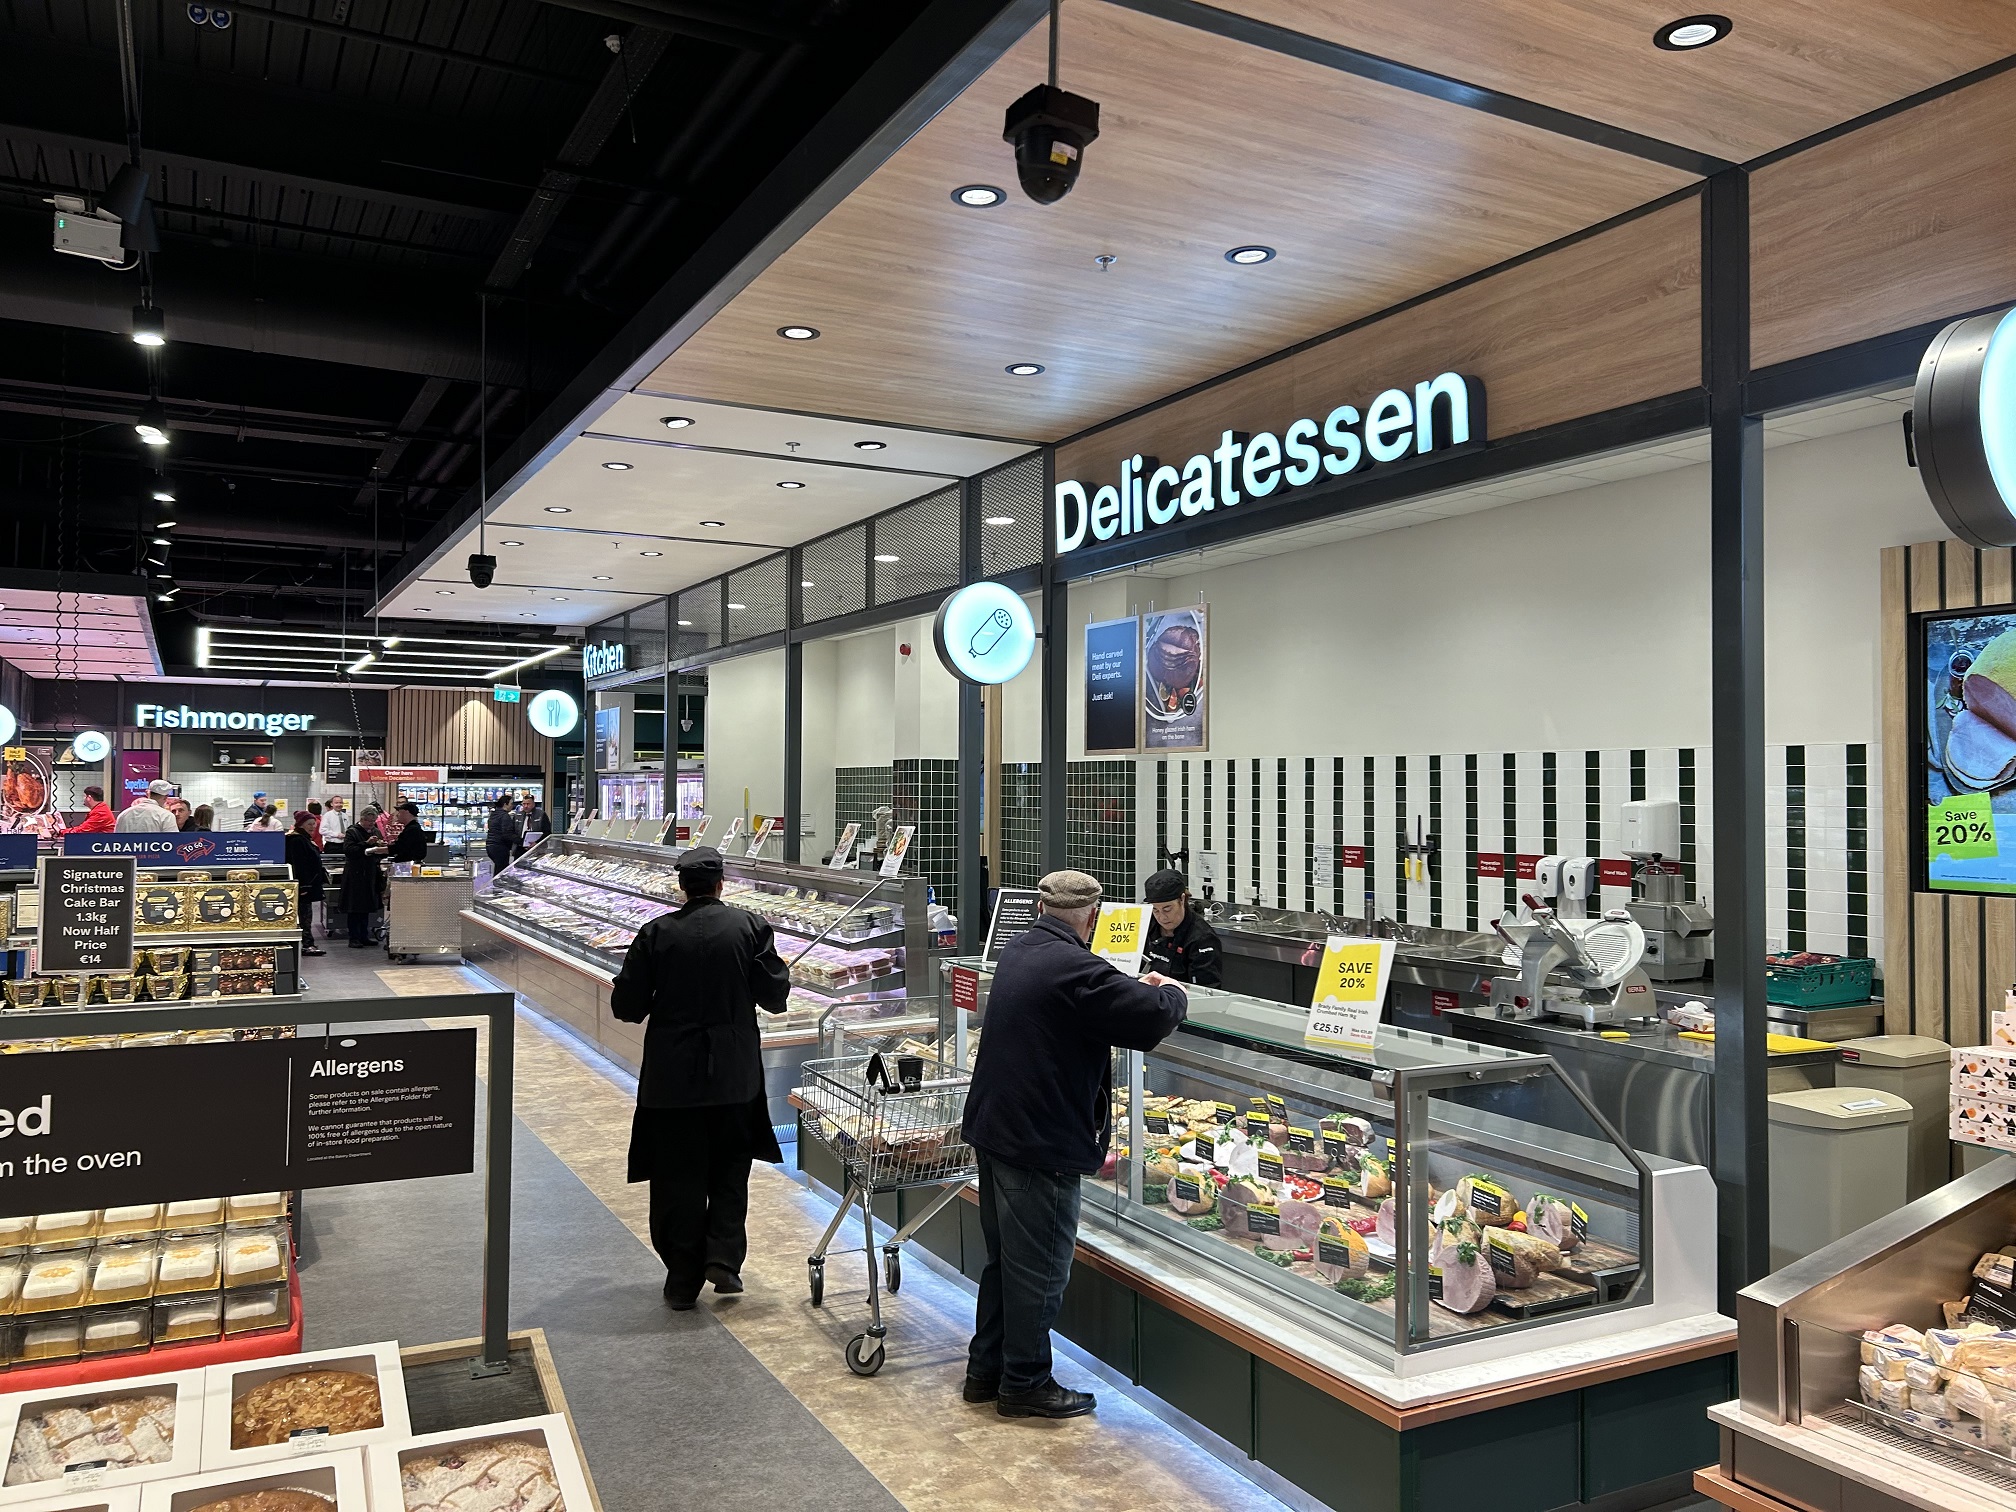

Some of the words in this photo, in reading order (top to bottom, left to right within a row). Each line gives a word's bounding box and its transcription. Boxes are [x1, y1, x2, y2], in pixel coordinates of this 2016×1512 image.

[1055, 371, 1470, 554] Delicatessen
[583, 640, 624, 679] Kitchen
[1092, 652, 1105, 660] Hand
[1106, 649, 1124, 659] carved
[1092, 662, 1104, 670] meat
[1104, 662, 1111, 670] by
[1102, 671, 1122, 680] experts.
[1092, 693, 1102, 701] Just
[1103, 692, 1114, 700] ask!
[136, 704, 314, 736] Fishmonger
[1945, 810, 1977, 822] Save
[1936, 822, 1992, 846] 20%
[92, 842, 173, 853] CARAMICO
[182, 845, 194, 853] TO
[62, 869, 124, 882] Signature
[60, 884, 124, 894] Christmas
[64, 898, 96, 908] Cake
[100, 898, 120, 907] Bar
[76, 912, 108, 924] 1.3kg
[62, 926, 91, 936] Now
[94, 926, 120, 936] Half
[1110, 922, 1135, 931] SAVE
[1110, 934, 1130, 943] 20%
[74, 940, 107, 950] Price
[80, 954, 102, 964] €14
[1338, 962, 1372, 974] SAVE
[1340, 978, 1365, 988] 20%
[1313, 1022, 1344, 1035] €25.51
[310, 1058, 404, 1078] Allergens
[330, 1091, 360, 1099] products
[308, 1101, 331, 1109] please
[370, 1095, 400, 1104] Allergens
[332, 1105, 372, 1114] information.
[345, 1121, 378, 1130] guarantee
[393, 1117, 422, 1125] products
[360, 1134, 400, 1144] preparation.
[23, 1154, 68, 1176] the
[77, 1150, 141, 1171] oven
